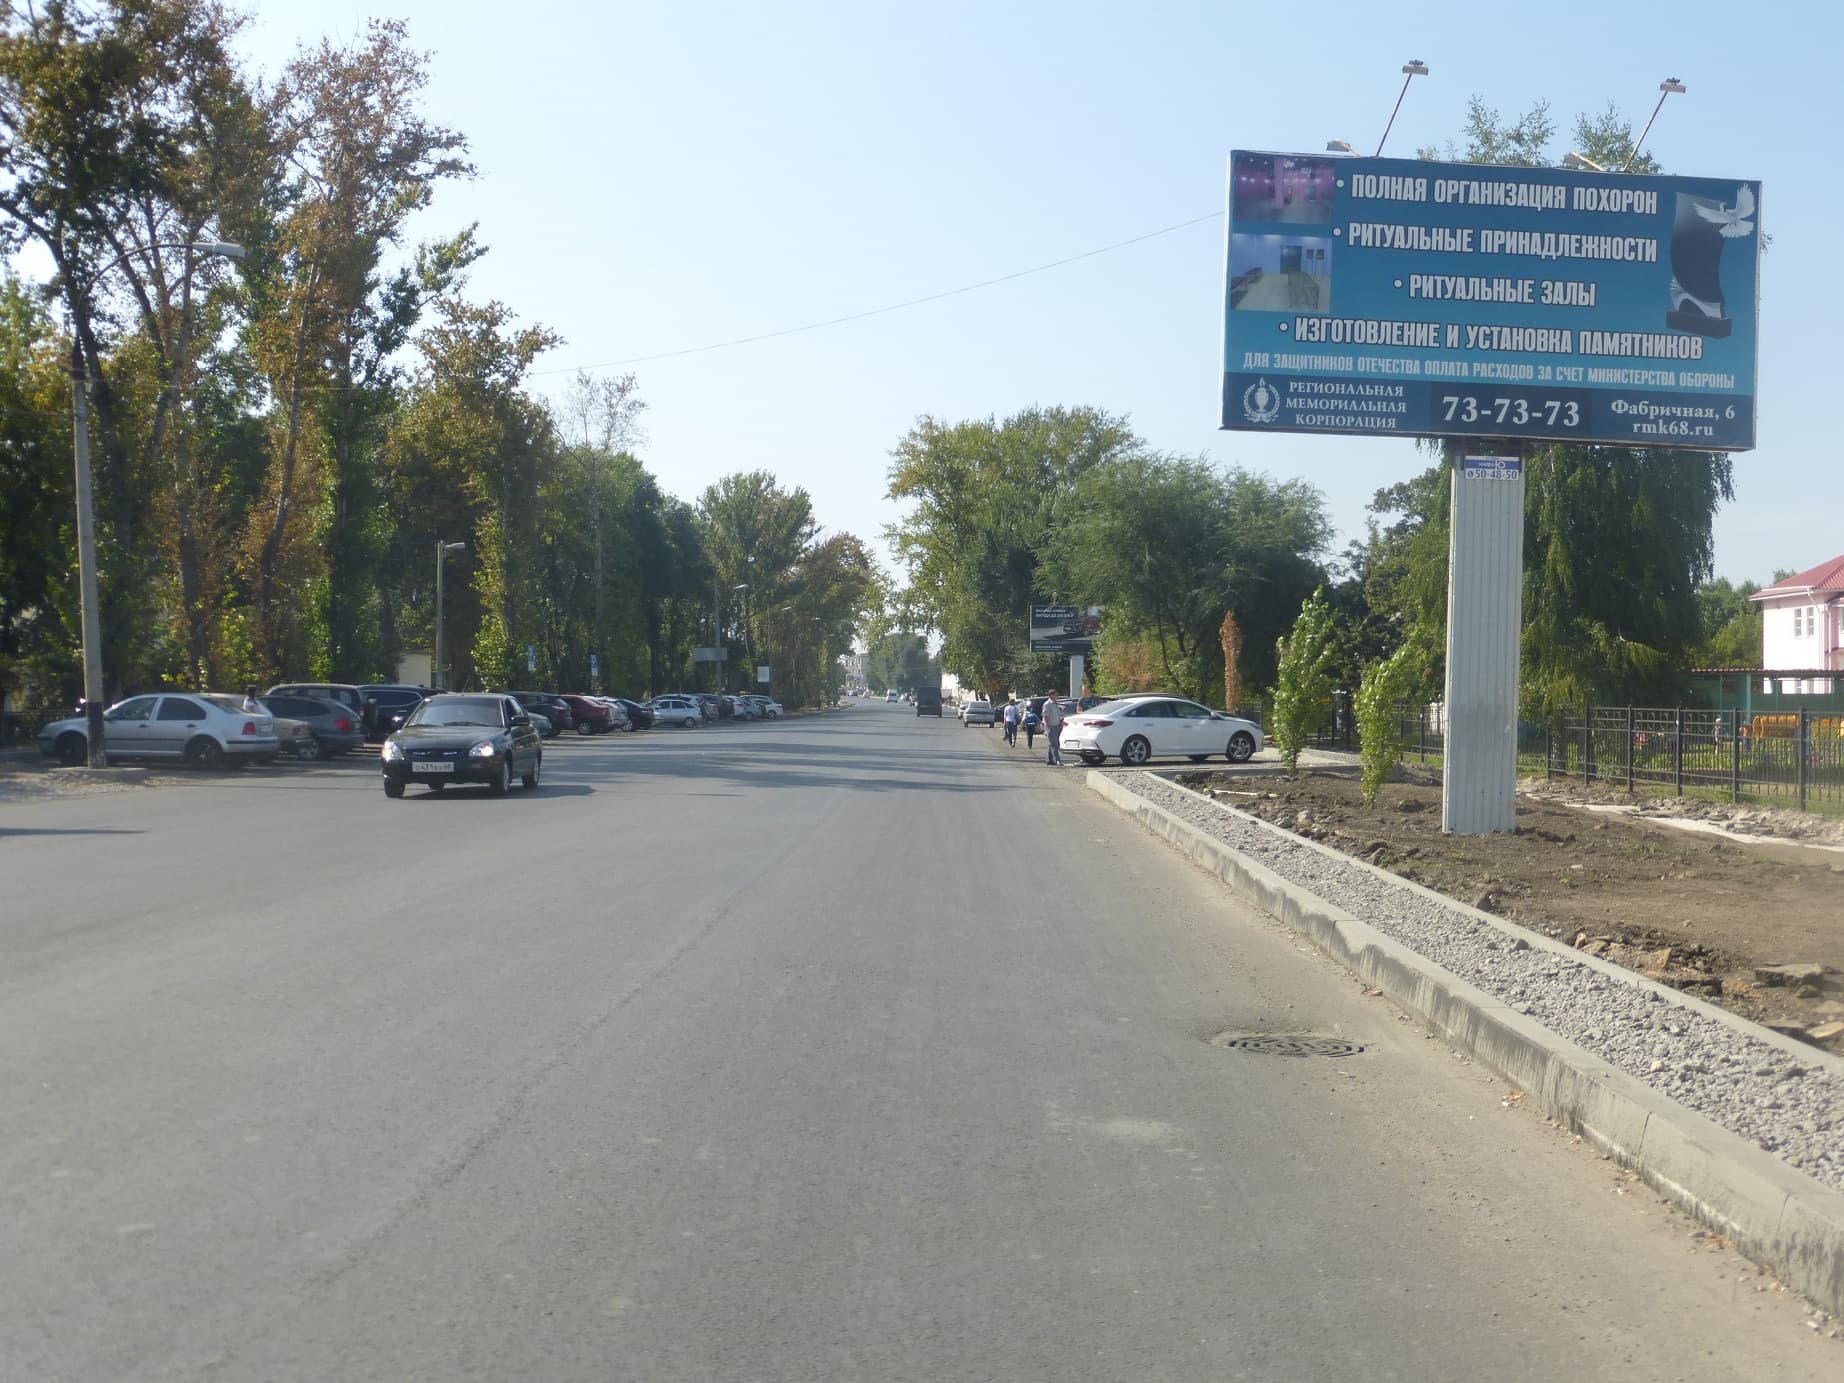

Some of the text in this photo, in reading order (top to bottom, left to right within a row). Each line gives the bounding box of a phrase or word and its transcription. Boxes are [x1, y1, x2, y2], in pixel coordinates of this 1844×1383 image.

[1351, 174, 1658, 215] ПОЛНАЯ ОРГАНИЗАЦИЯ ПОХОРОН
[1348, 222, 1657, 263] РИТУАЛЬНЫЕ ПРИНАДЛЕЖНОСТИ
[1409, 274, 1596, 307] РИТУАЛЬНЫЕ ЗАЛЫ
[1295, 316, 1703, 360] ИЗГОТОВЛЕНИЕ И УСТАНОВКА ПАМЯТНИКОВ
[1243, 352, 1735, 389] ДЛЯ ЗАЩИТНИКОВ ОТЕЧЕСТВА ОПЛАТА РАСХОДОВ ЗА СЧЕТ МИНИСТЕРСТВА ОБОРОНЫ
[1289, 381, 1404, 397] РЕГИОНАЛЬНАЯ
[1286, 398, 1407, 413] МЕМОРИАЛЬНАЯ
[1442, 396, 1580, 427] 73-73-73
[1611, 399, 1735, 420] Фабричная, 6
[1295, 415, 1396, 429] КОРПОРАЦИЯ
[1633, 420, 1714, 436] rmk68.ru
